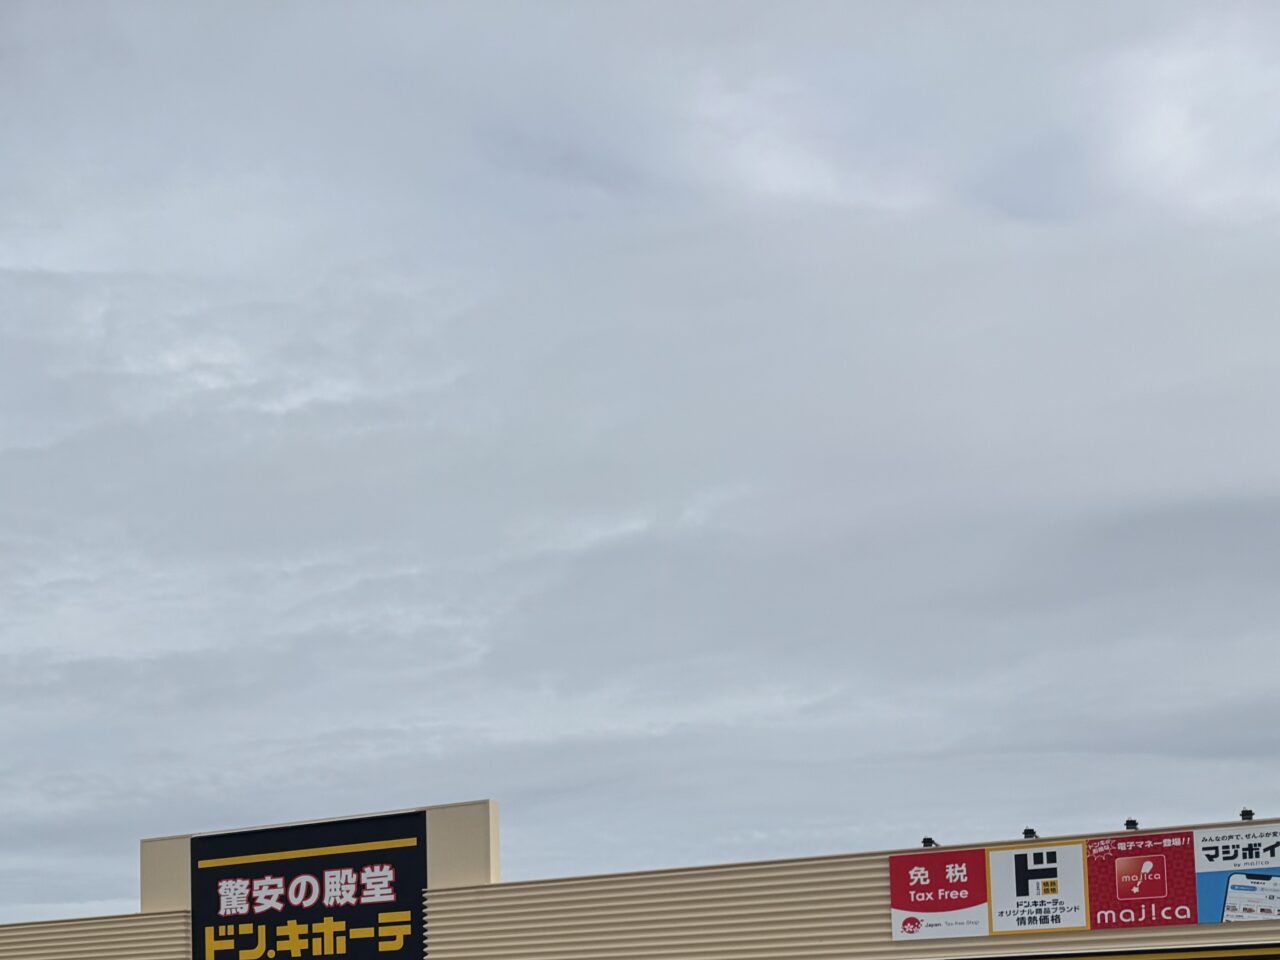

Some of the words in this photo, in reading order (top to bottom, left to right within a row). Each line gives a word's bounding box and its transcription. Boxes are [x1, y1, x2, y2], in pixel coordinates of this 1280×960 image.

[1201, 831, 1280, 842] みんなの声で、ぜんぶが変
[218, 864, 396, 917] 驚安の殿堂
[909, 890, 934, 902] Tax
[938, 888, 969, 900] Free
[1016, 914, 1061, 926] 情熱価格
